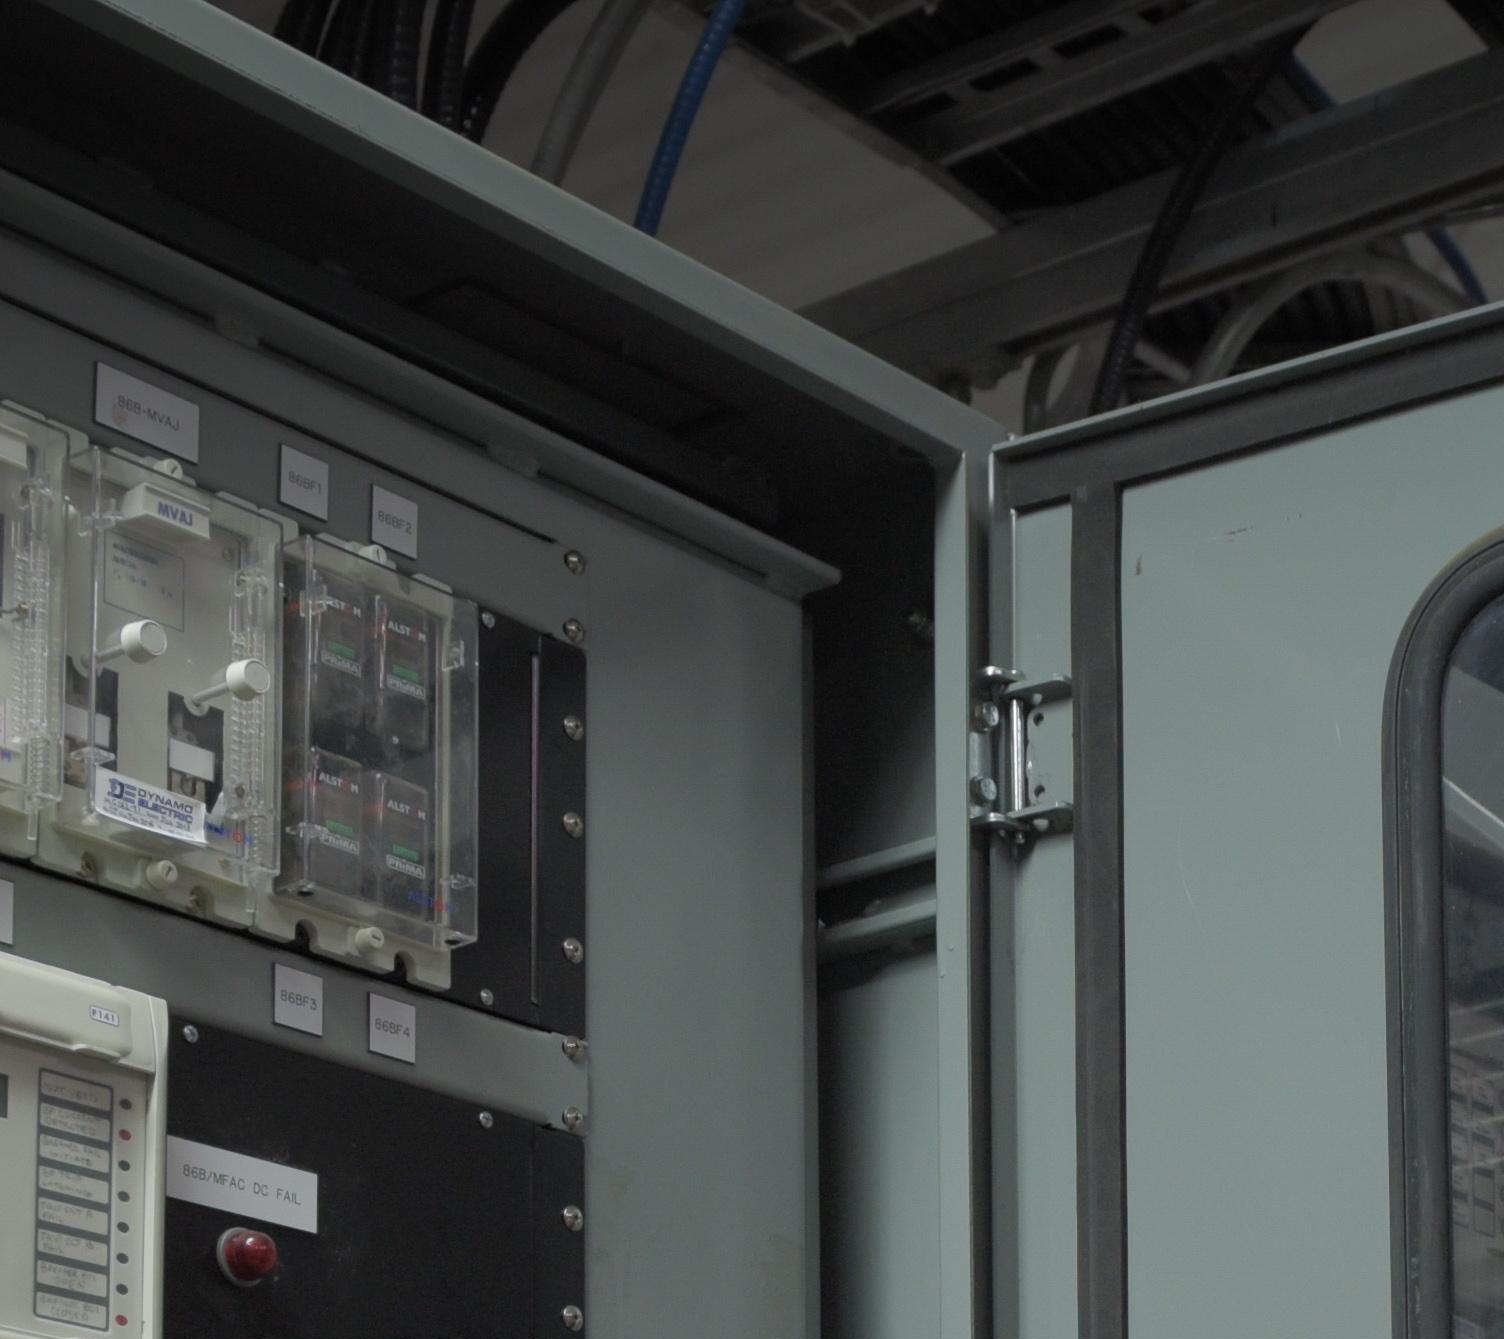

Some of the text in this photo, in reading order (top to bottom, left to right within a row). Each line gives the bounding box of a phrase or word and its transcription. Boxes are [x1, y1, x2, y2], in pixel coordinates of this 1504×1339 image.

[115, 392, 182, 436] 86B-MVAJ
[286, 468, 324, 497] 86BF1
[157, 500, 195, 529] MVAJ
[375, 508, 414, 537] 86BF2
[137, 786, 194, 815] DYNAMO
[137, 797, 194, 826] ELECTRIC
[279, 987, 320, 1013] 86BF3
[90, 1007, 116, 1024] P141
[373, 1016, 412, 1040] 86BF4
[181, 1160, 303, 1208] 86B/MFAC DC FAIL
